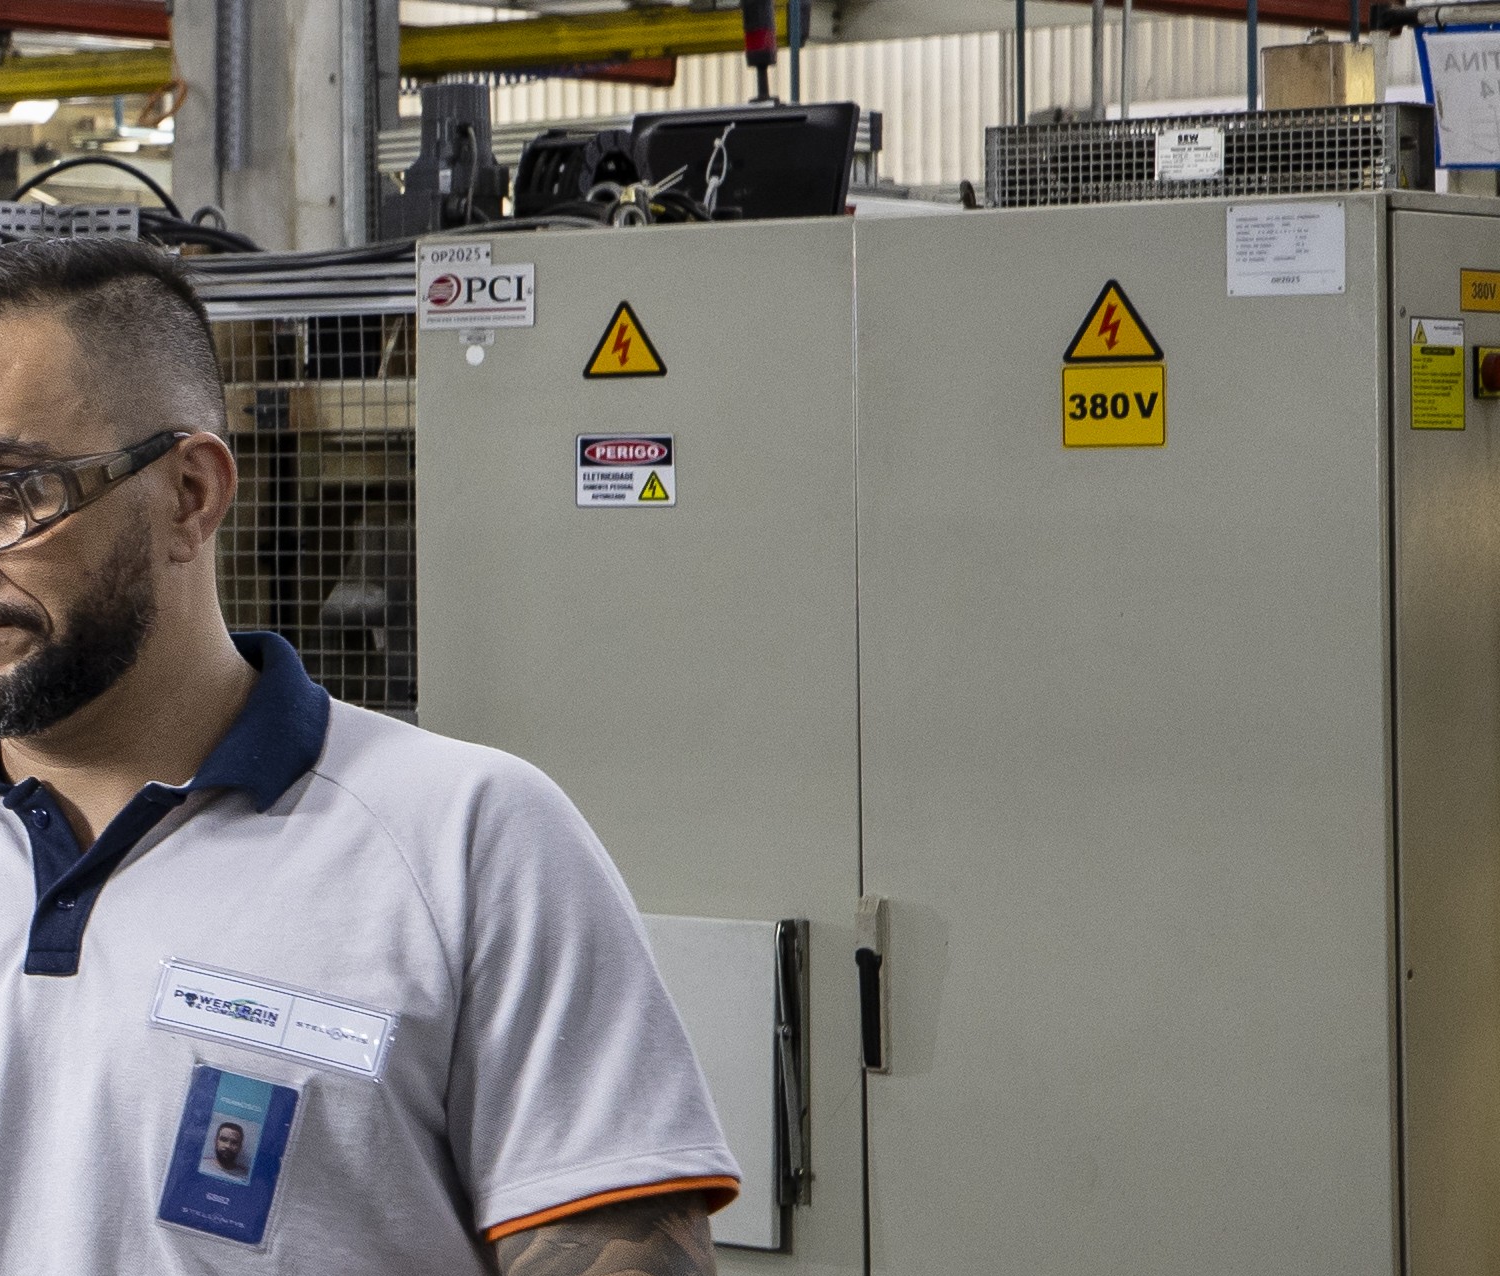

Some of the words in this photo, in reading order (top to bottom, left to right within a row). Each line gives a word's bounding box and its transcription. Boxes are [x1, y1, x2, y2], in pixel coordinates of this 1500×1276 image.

[431, 248, 481, 263] OP2025
[464, 275, 525, 304] PCI
[1471, 282, 1496, 300] 380V
[1068, 391, 1159, 420] 380V
[595, 445, 660, 460] PERIGO
